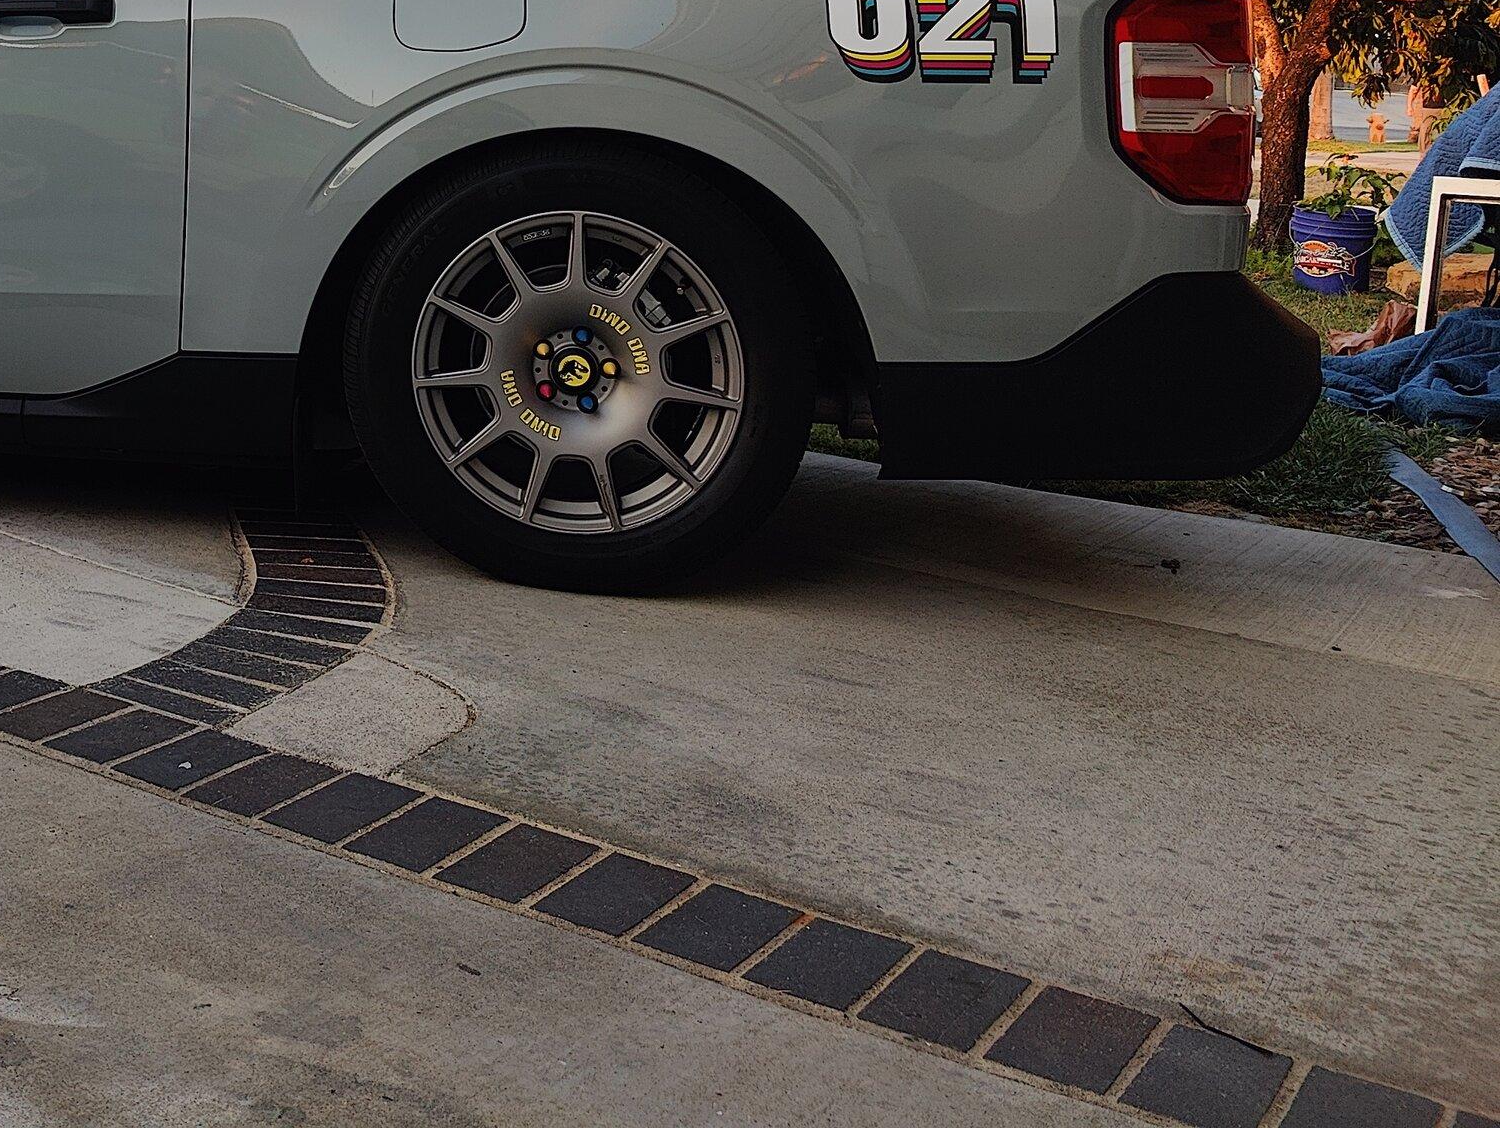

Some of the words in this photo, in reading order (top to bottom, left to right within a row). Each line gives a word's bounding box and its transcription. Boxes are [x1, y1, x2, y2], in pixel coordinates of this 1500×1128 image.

[588, 303, 632, 336] DINO
[626, 337, 650, 375] DNA
[500, 369, 524, 409] DNA
[519, 407, 562, 442] DINO
